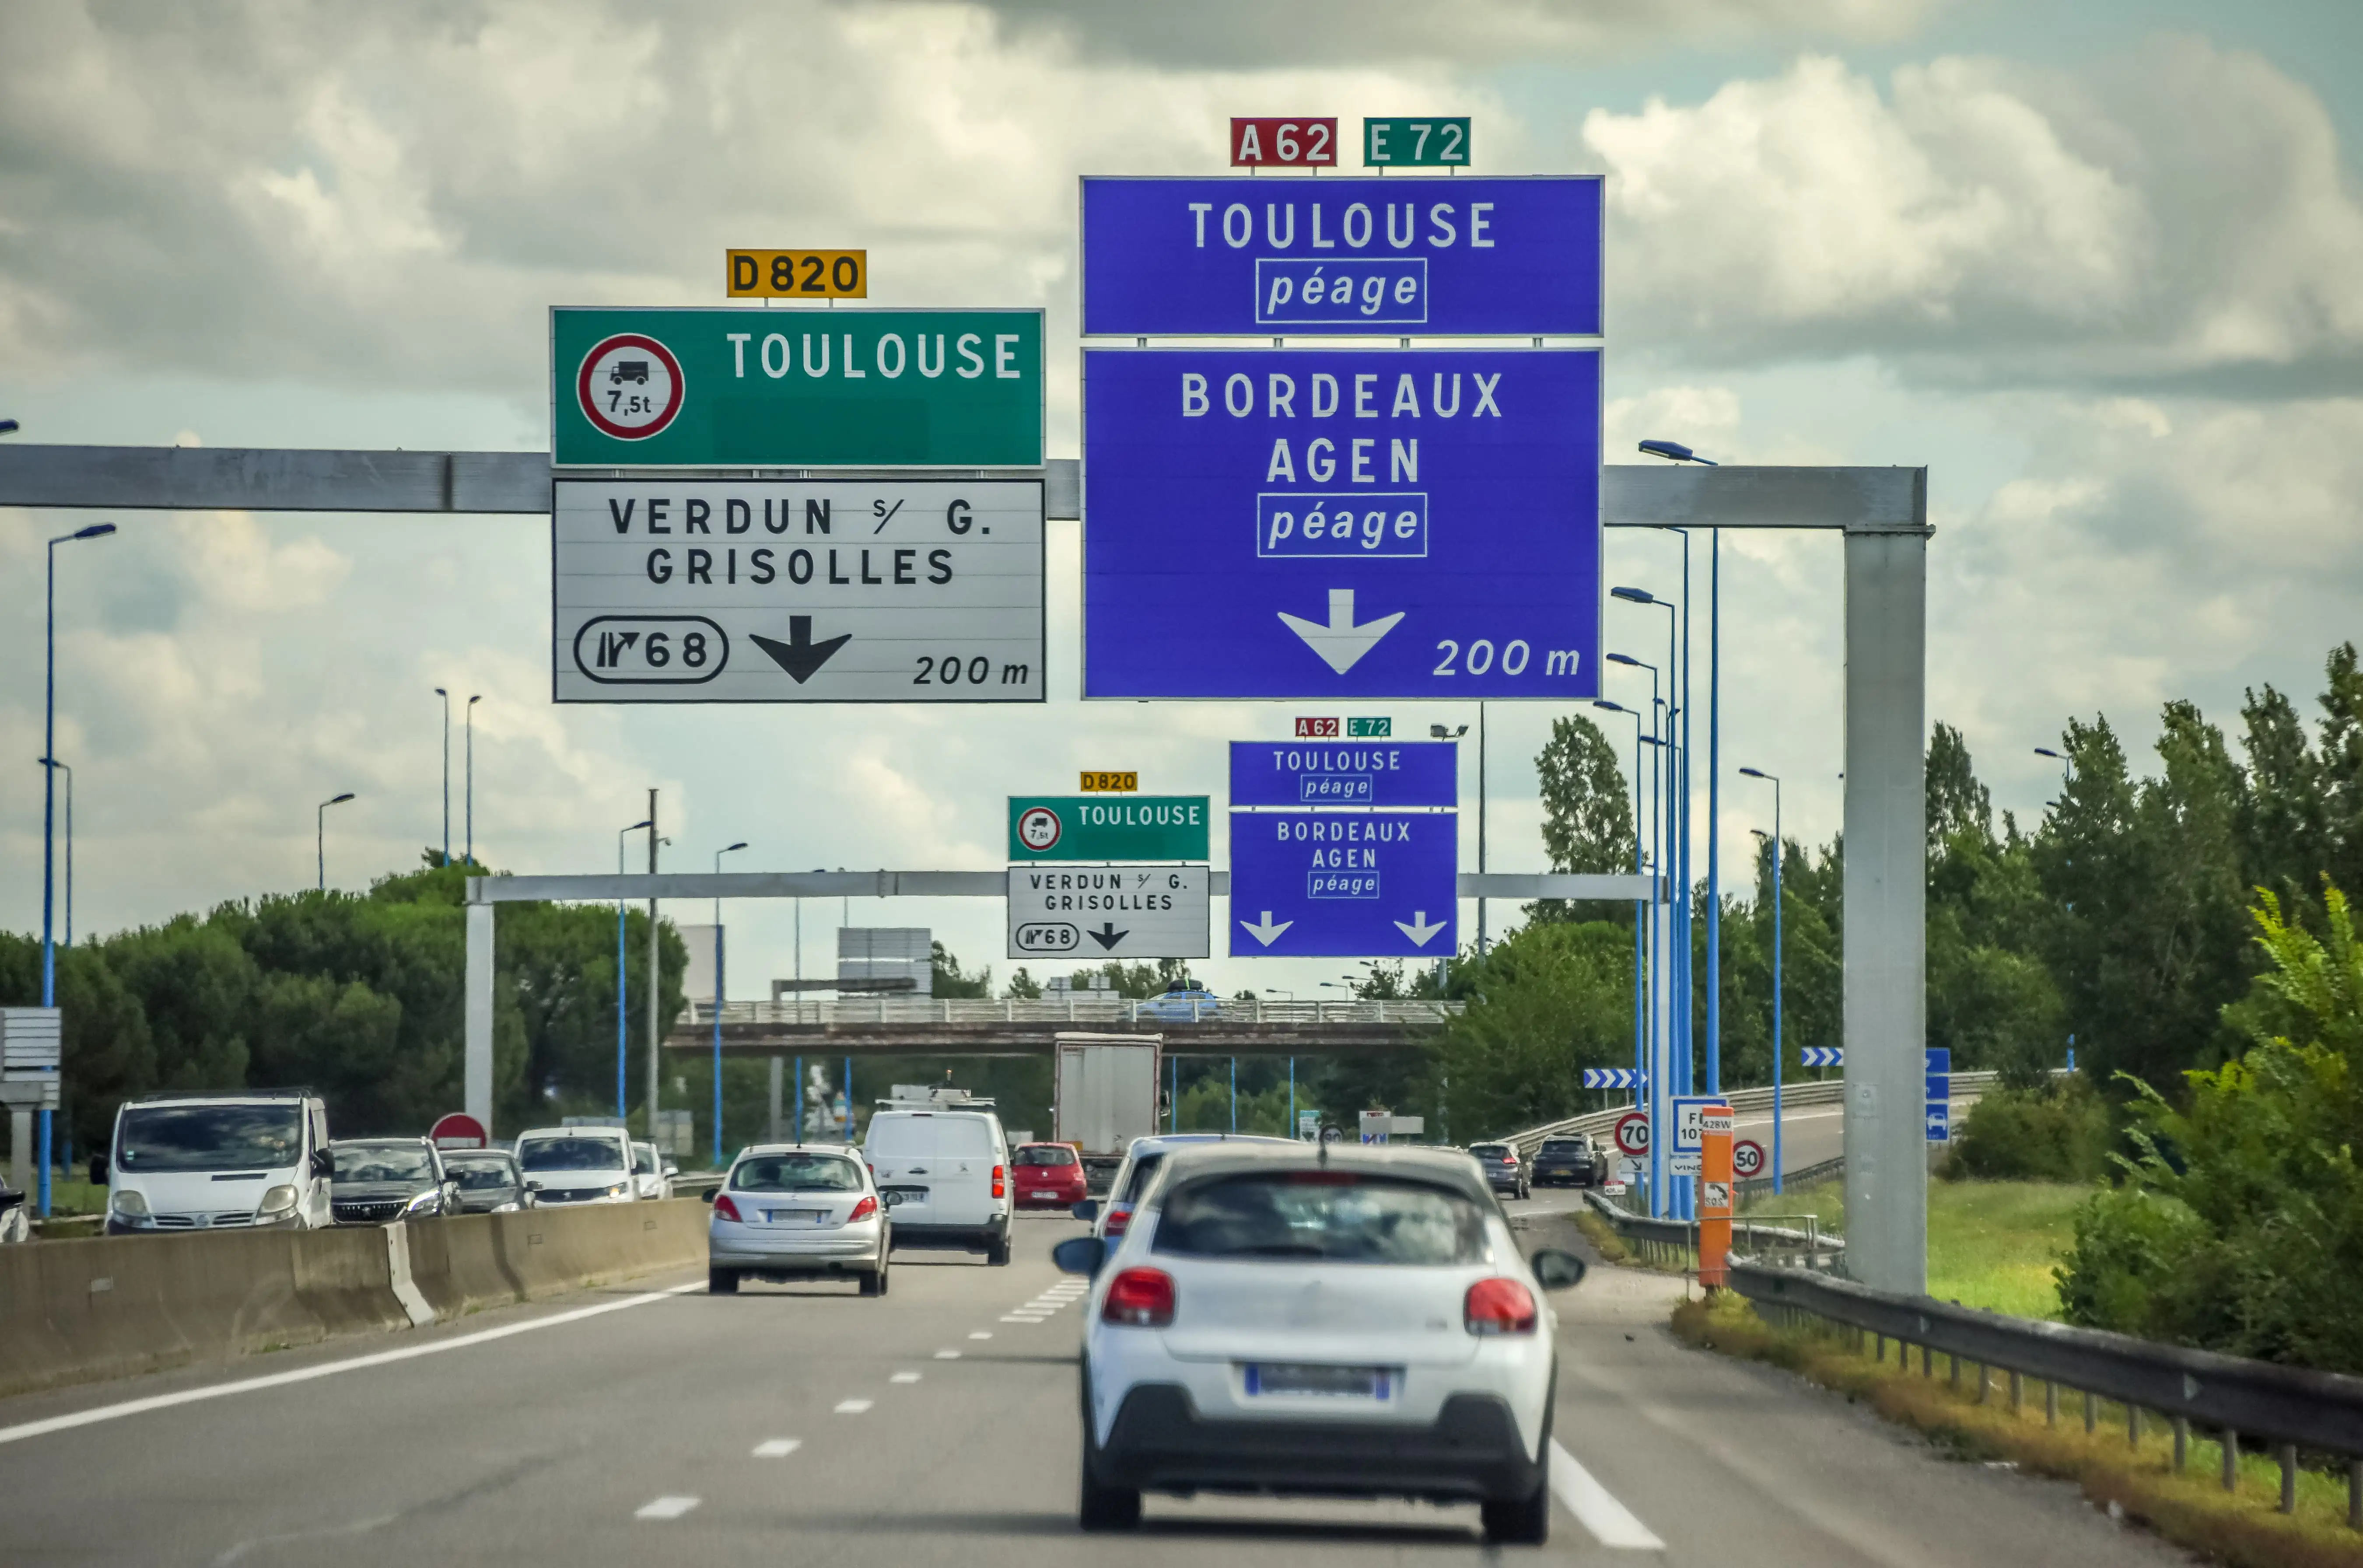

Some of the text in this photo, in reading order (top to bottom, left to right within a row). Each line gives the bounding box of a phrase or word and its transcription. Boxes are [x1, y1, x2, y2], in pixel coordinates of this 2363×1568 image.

[1239, 124, 1329, 161] A 62
[1372, 124, 1462, 160] E 72
[1189, 203, 1494, 249] TOULOUSE
[1267, 266, 1416, 315] péage
[727, 333, 1020, 378] TOULOUSE
[607, 391, 651, 416] 7,5t
[1183, 373, 1501, 417] BORDEAUX
[1267, 438, 1417, 482] AGEN
[609, 499, 830, 534] VERDUN
[947, 499, 990, 535] G.
[1268, 502, 1417, 549] péage
[647, 549, 952, 584] GRISOLLES
[646, 633, 706, 667] 68
[1433, 640, 1579, 675] 200 m
[914, 657, 1028, 684] 200 m
[1350, 720, 1388, 735] E 72
[1274, 751, 1399, 770] TOULOUSE
[1306, 779, 1367, 798] péage
[1079, 806, 1200, 825] TOULOUSE
[1278, 822, 1409, 841] BORDEAUX
[1313, 849, 1375, 867] AGEN
[1030, 874, 1120, 889] VERDUN
[1169, 874, 1187, 889] G.
[1313, 875, 1375, 894] péage
[1045, 895, 1171, 910] GRISOLLES
[1045, 929, 1070, 944] 68
[1623, 1126, 1648, 1144] 70
[1736, 1152, 1757, 1167] 50
